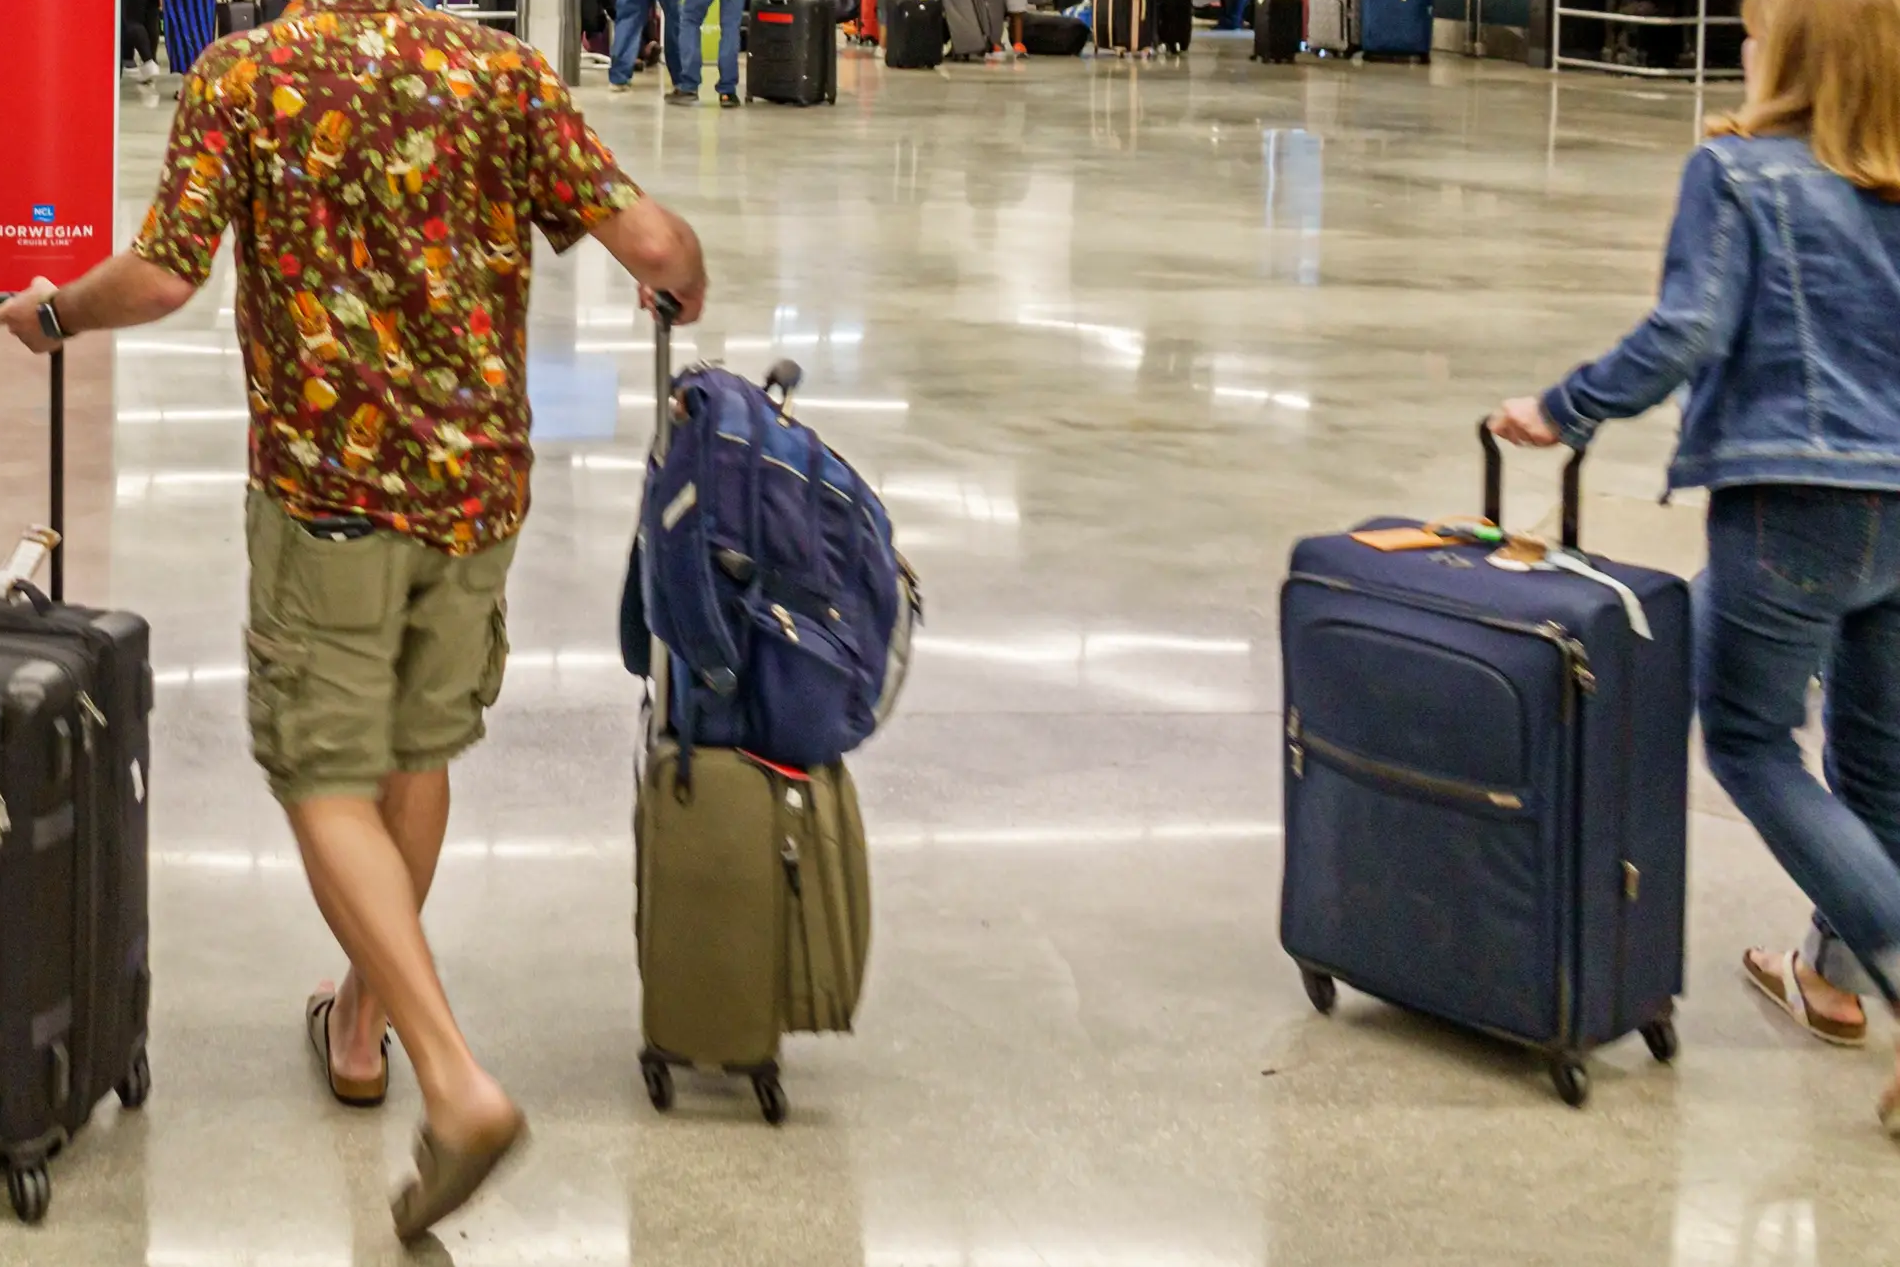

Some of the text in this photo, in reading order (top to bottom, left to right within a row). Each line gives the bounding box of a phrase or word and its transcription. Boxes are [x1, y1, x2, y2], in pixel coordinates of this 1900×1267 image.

[34, 207, 54, 217] NCL
[17, 238, 70, 247] CRUISE LINE
